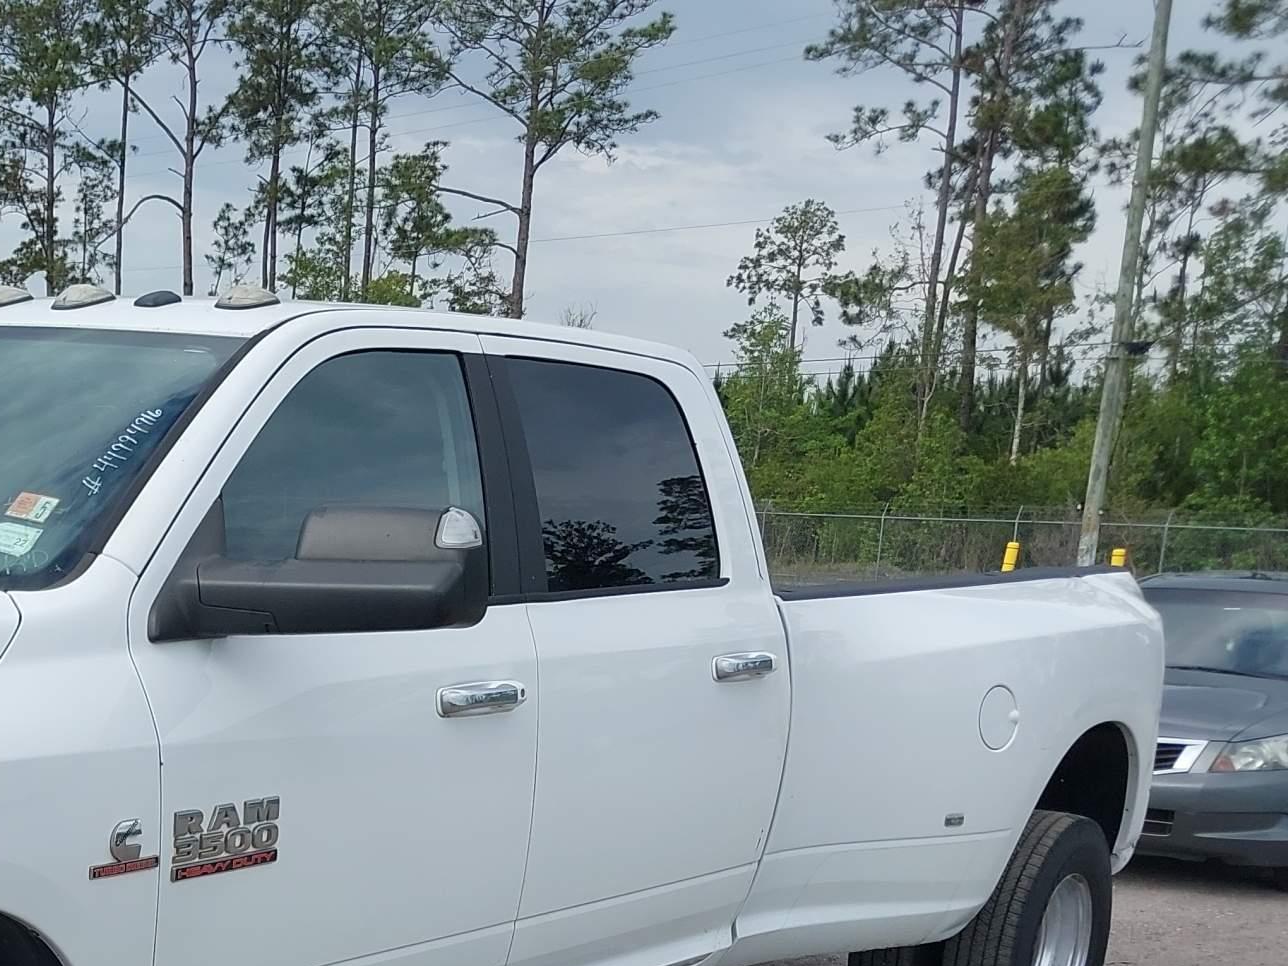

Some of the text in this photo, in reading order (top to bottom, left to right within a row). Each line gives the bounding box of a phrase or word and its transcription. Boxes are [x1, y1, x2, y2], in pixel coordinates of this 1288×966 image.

[173, 795, 280, 837] RAM
[171, 821, 279, 864] 3500
[93, 863, 126, 879] TURBO
[177, 850, 275, 880] HEAVY DUTY
